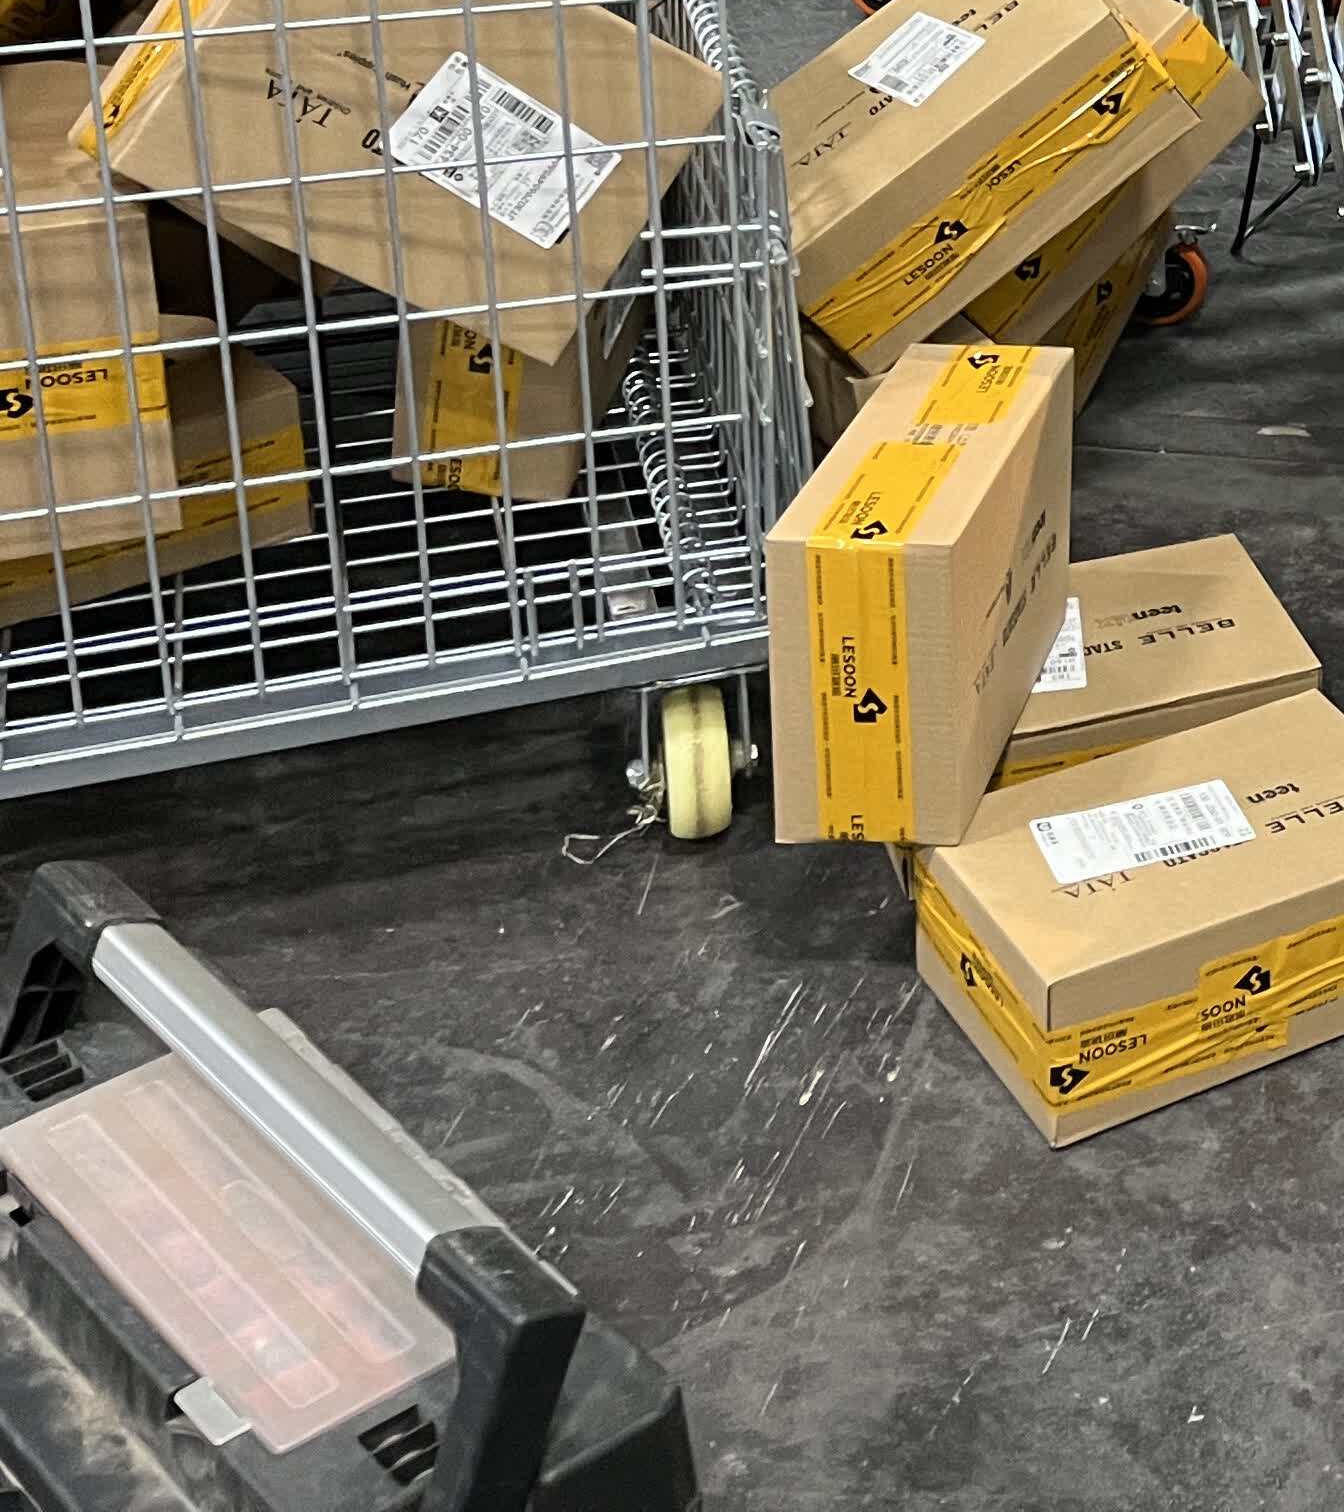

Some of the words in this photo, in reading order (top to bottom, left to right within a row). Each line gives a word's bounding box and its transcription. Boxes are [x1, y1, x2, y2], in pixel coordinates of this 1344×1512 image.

[903, 243, 954, 286] LESOON
[1138, 618, 1236, 646] BELLE
[841, 634, 858, 698] LESOON
[1079, 1033, 1148, 1065] LESOON
